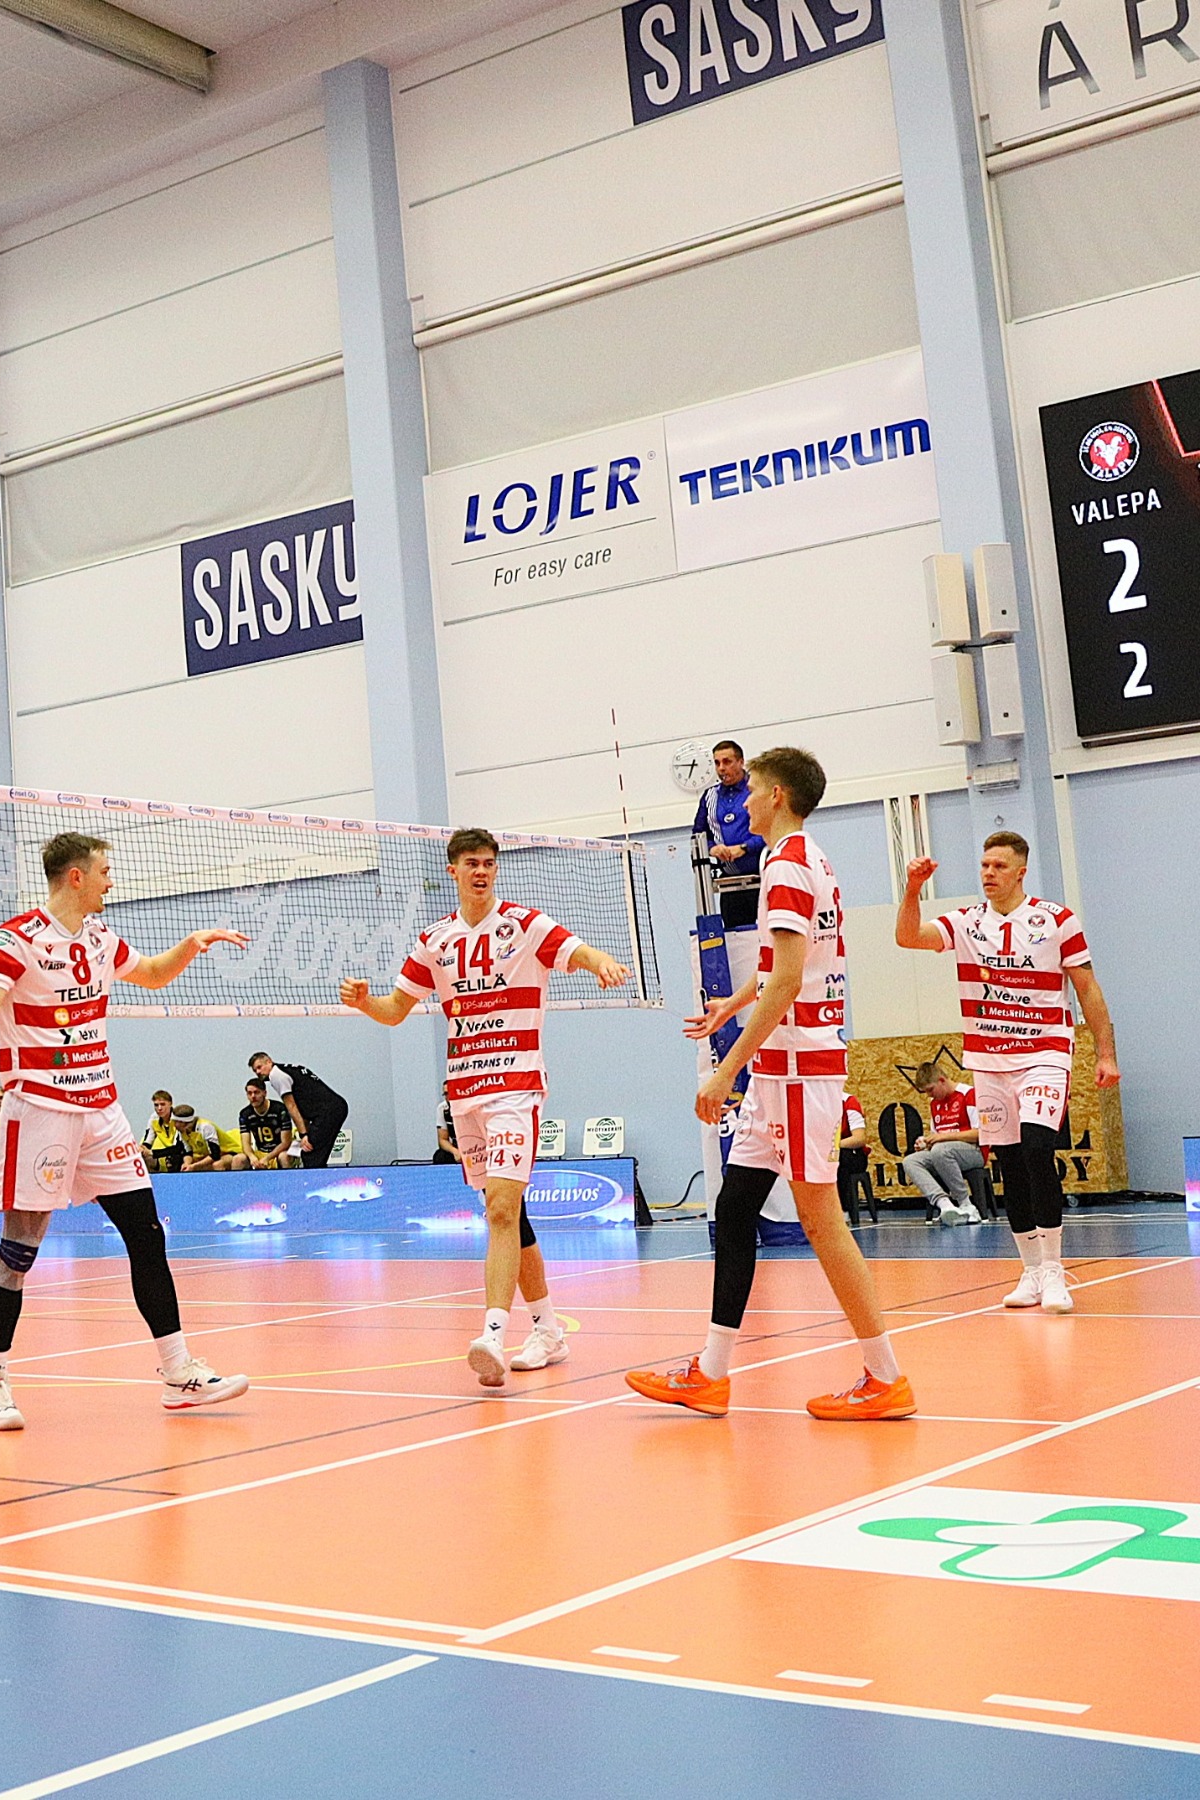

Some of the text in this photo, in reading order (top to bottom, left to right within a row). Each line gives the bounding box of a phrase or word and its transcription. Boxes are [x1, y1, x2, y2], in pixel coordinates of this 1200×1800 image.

[678, 417, 931, 506] TEKNIKUM
[463, 455, 641, 544] LOJER
[1071, 487, 1162, 526] VALEPA
[493, 546, 613, 588] For easy care
[1102, 538, 1148, 614] 2
[1119, 641, 1153, 699] 2
[453, 933, 494, 979] 14
[997, 922, 1016, 955] 1
[69, 943, 91, 985] 8
[462, 1036, 518, 1053] Metsätilat.fi
[1035, 1100, 1043, 1115] 1
[257, 1126, 275, 1144] 19
[133, 1158, 145, 1177] 8
[489, 1149, 506, 1167] 14
[524, 1183, 600, 1204] laneuvos
